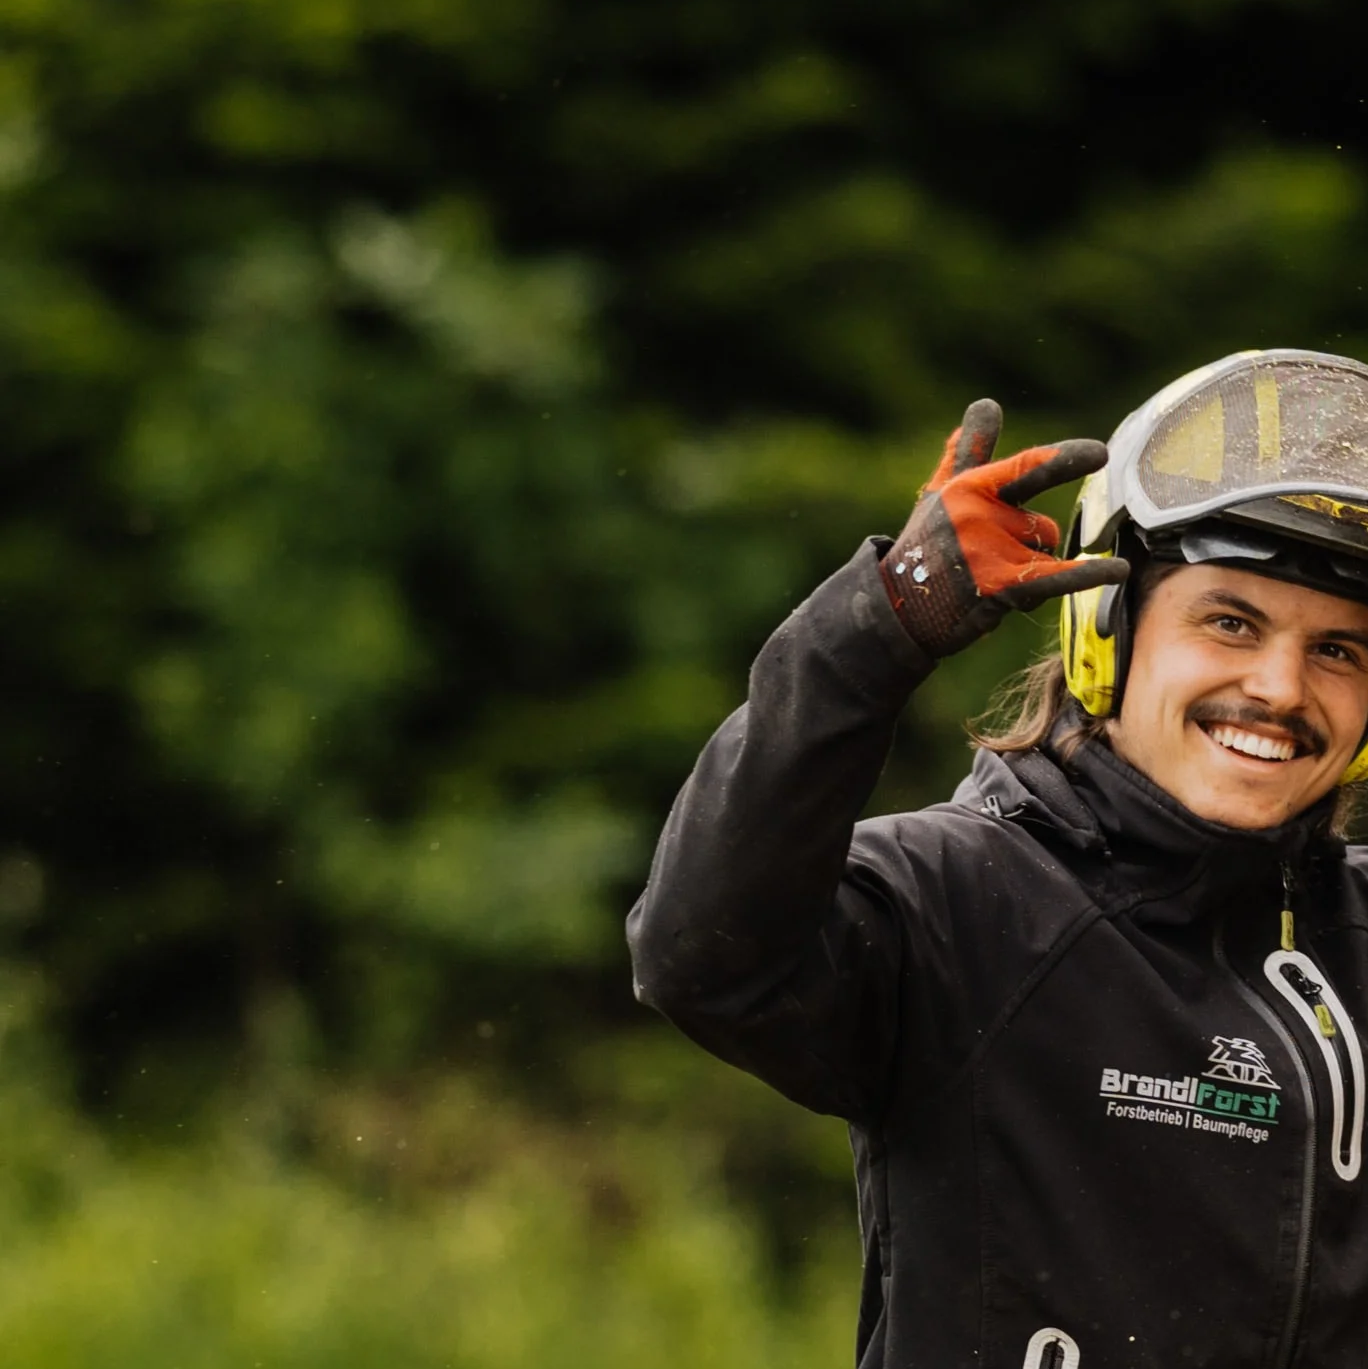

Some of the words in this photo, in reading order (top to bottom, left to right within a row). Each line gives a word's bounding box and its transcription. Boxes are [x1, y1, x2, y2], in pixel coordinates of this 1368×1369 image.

[1101, 1068, 1281, 1117] BrandlForst
[1107, 1101, 1183, 1126] Forstbetrieb
[1193, 1114, 1269, 1143] Baumpflege
